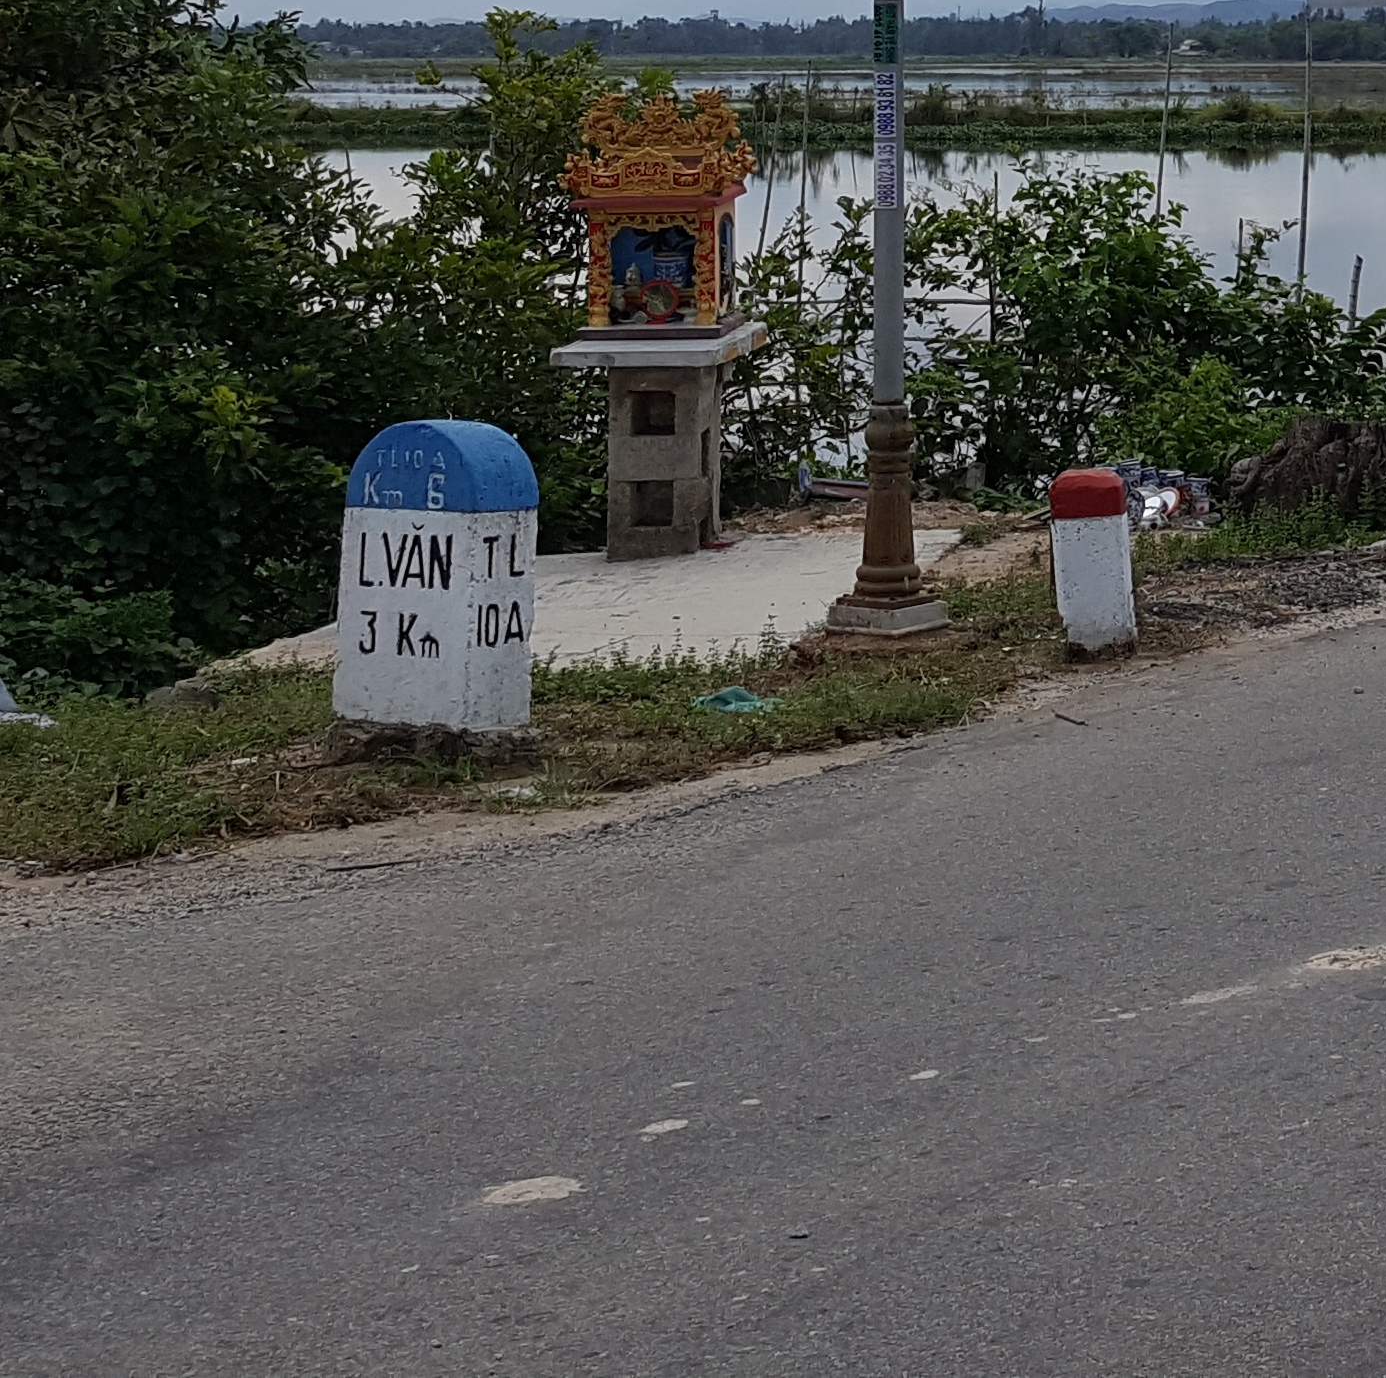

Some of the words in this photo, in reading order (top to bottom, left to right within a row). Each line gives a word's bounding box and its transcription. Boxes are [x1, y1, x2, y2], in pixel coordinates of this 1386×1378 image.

[363, 472, 404, 505] Km
[427, 473, 446, 509] 6
[358, 610, 378, 655] 3
[397, 612, 440, 658] Km
